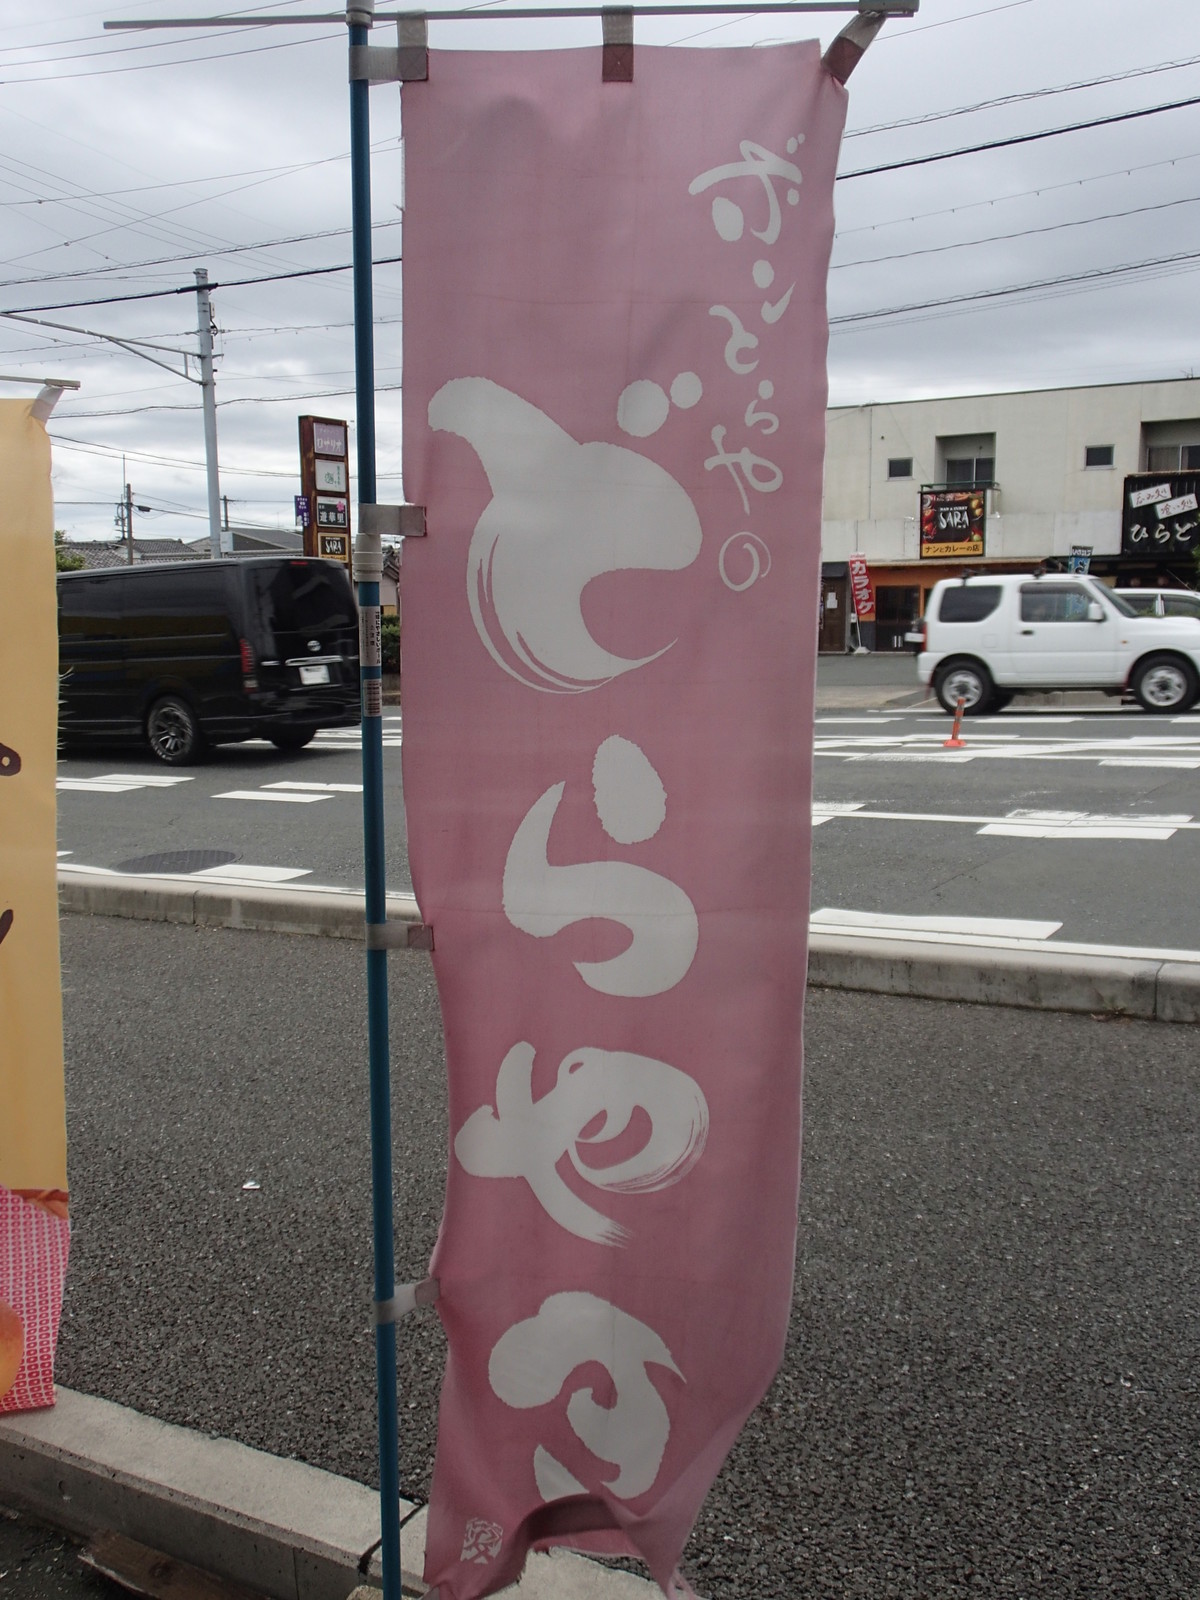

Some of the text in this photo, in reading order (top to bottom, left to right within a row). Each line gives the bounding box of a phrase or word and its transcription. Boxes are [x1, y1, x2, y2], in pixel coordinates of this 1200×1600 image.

[940, 511, 969, 529] SARA
[1131, 522, 1198, 543] ひらど
[925, 544, 980, 553] ナンとカレーの店
[851, 561, 875, 614] カラオケ
